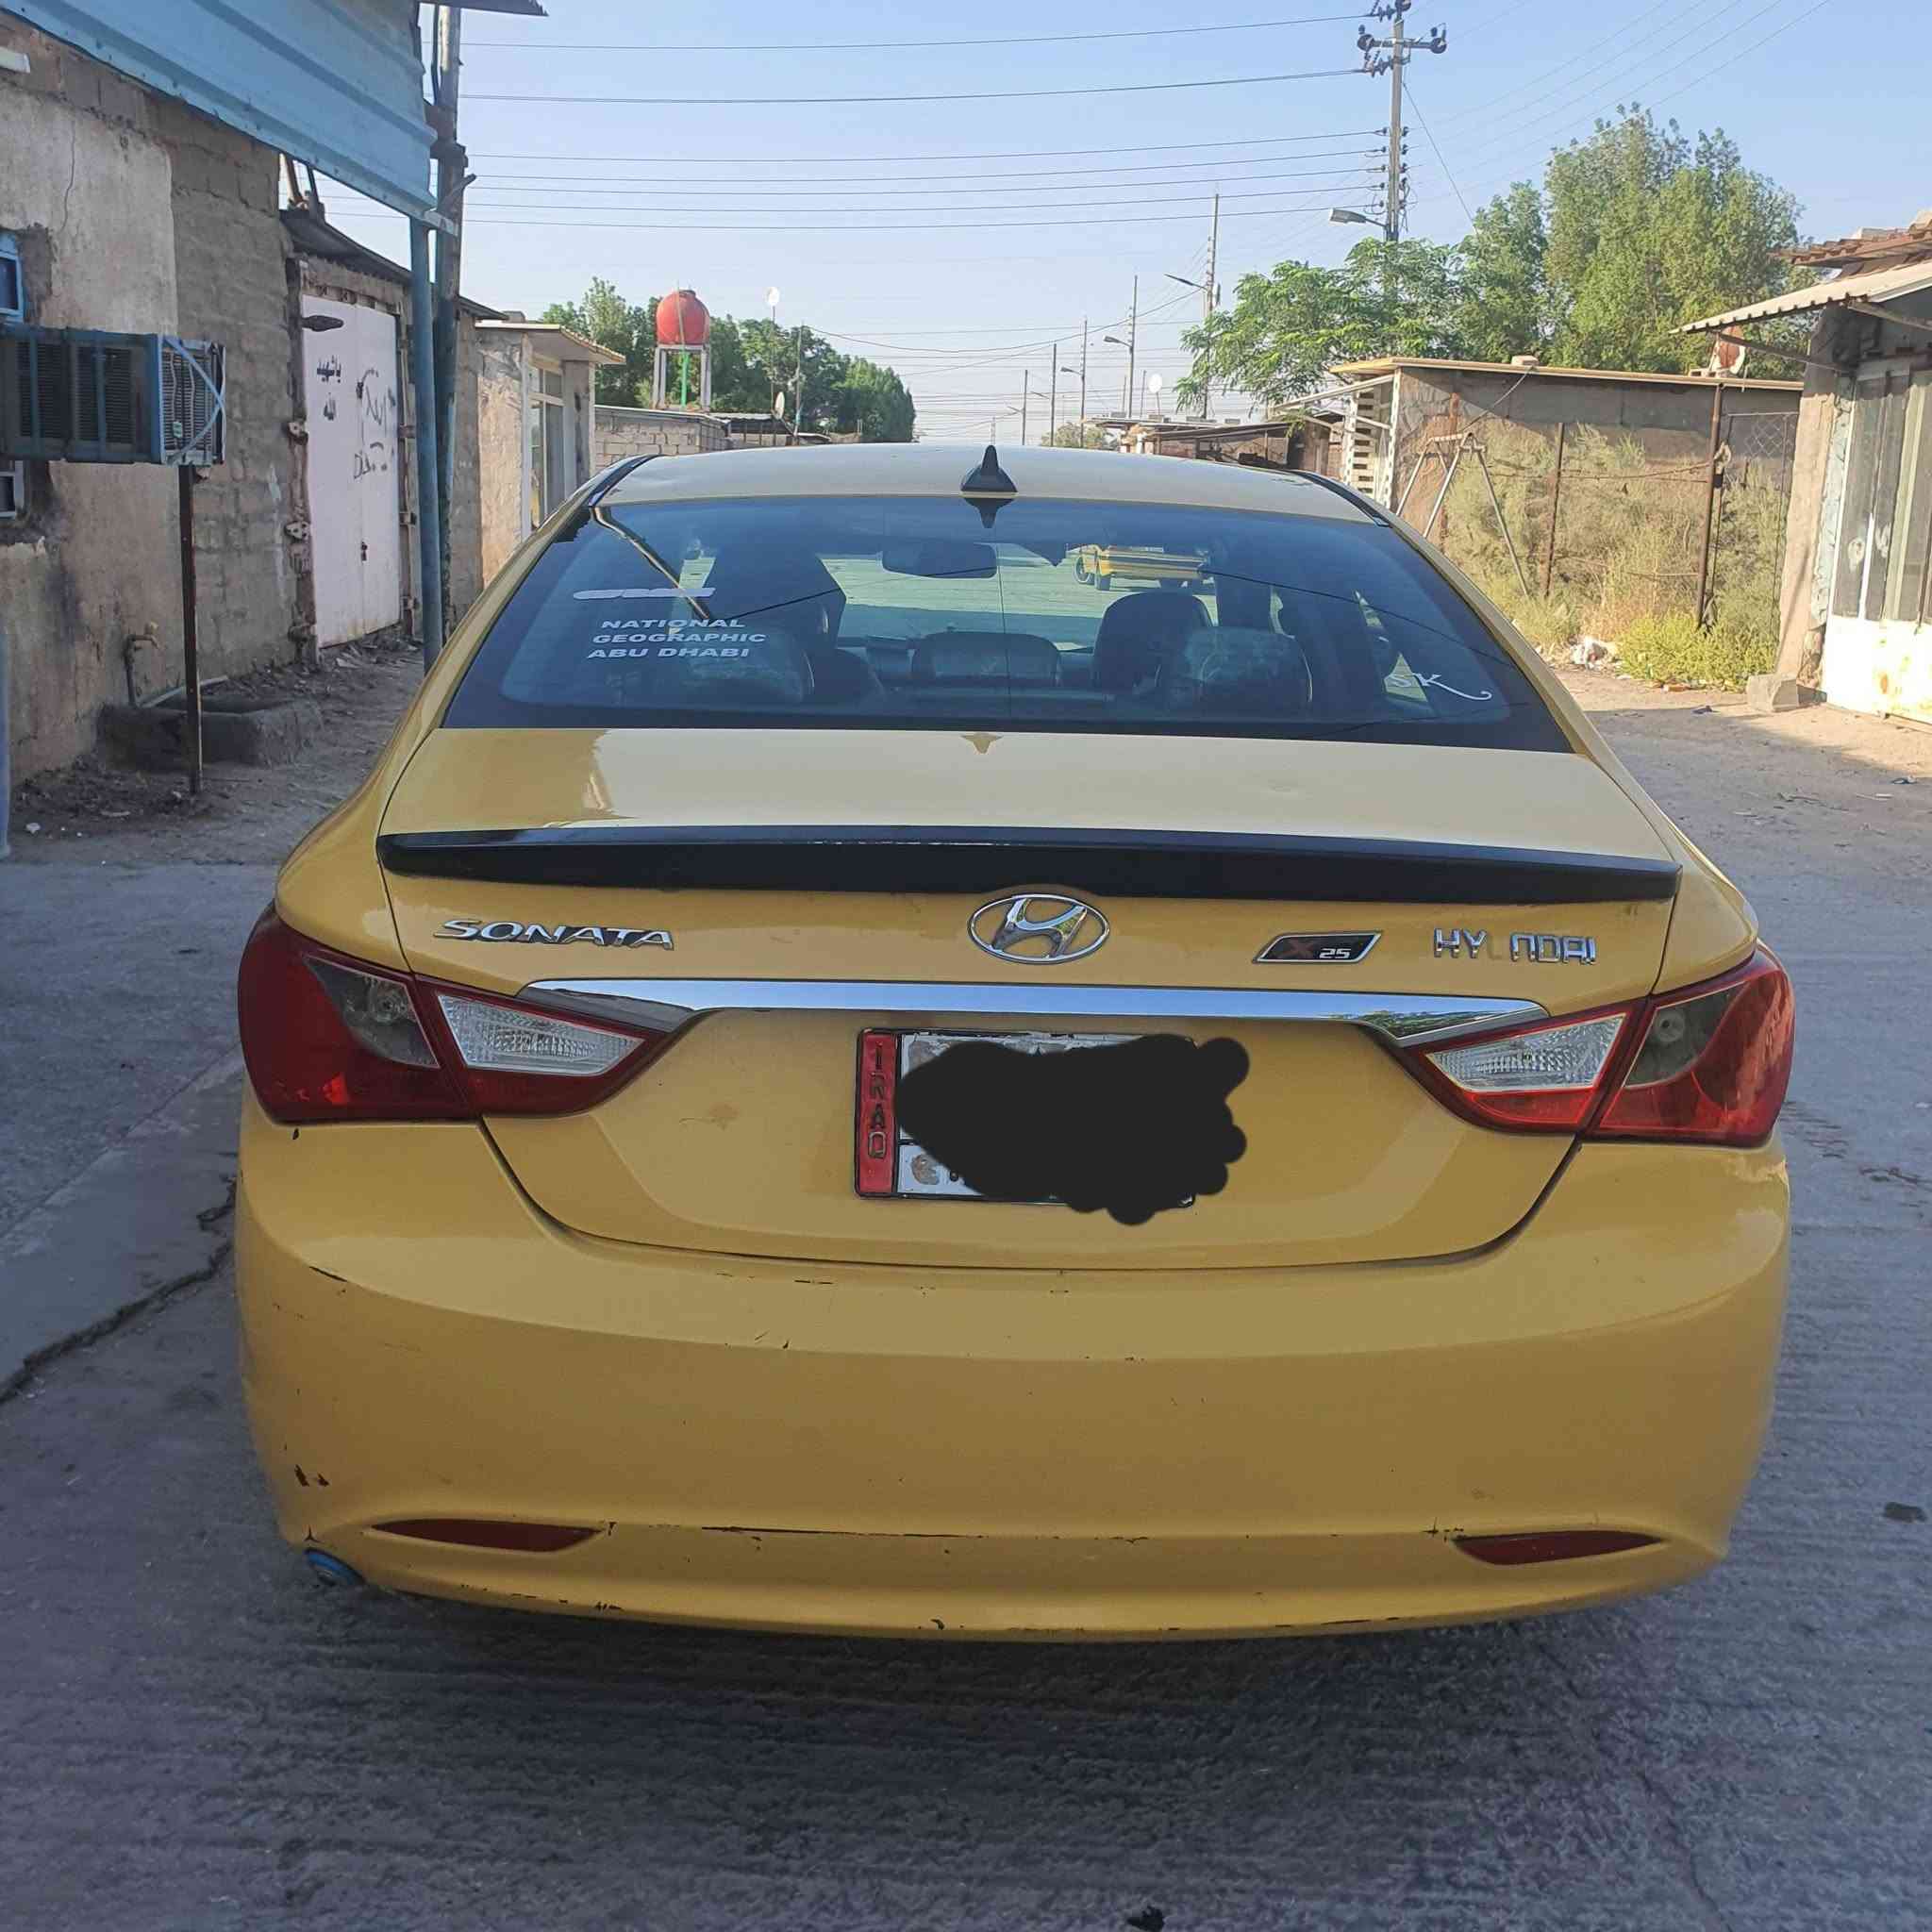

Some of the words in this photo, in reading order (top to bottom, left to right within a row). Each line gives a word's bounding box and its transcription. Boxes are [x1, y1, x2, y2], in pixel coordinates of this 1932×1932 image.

[600, 618, 746, 629] NATIONAL
[592, 633, 767, 644] GEOGRAPHIC
[587, 647, 649, 659] ABU
[657, 647, 750, 658] DHABI
[433, 919, 675, 952] SONATA
[1433, 927, 1597, 966] HYNDAI
